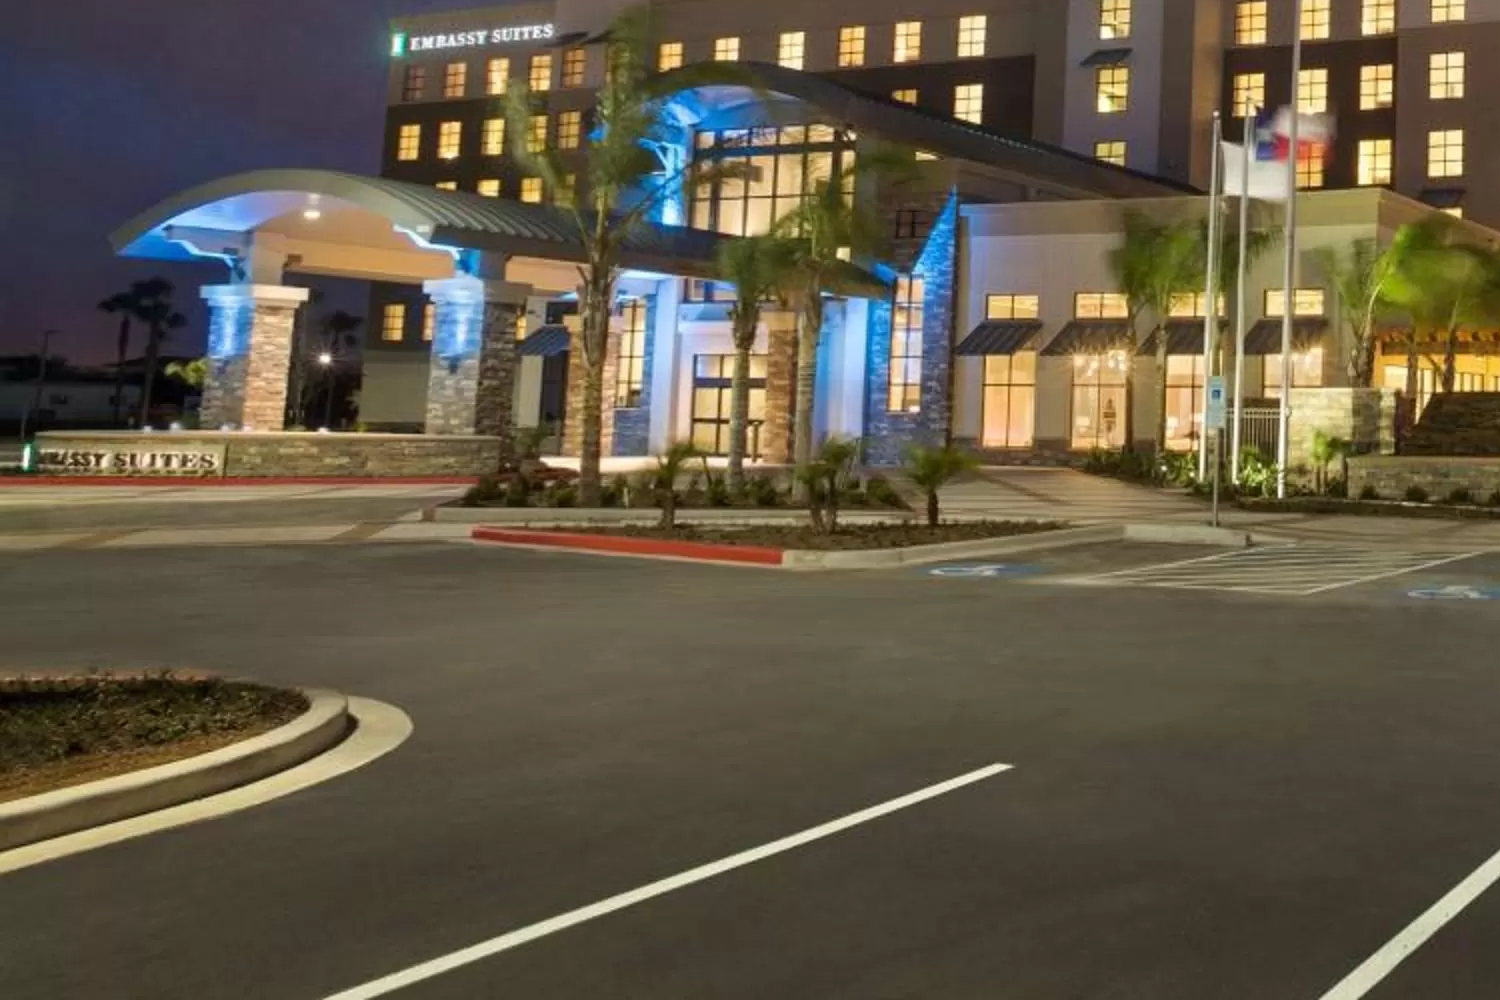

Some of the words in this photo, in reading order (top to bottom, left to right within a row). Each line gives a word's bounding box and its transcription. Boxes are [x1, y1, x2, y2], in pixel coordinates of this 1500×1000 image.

[409, 31, 487, 51] EMBASSY
[491, 23, 553, 43] SUITES
[113, 452, 216, 469] SUITES
